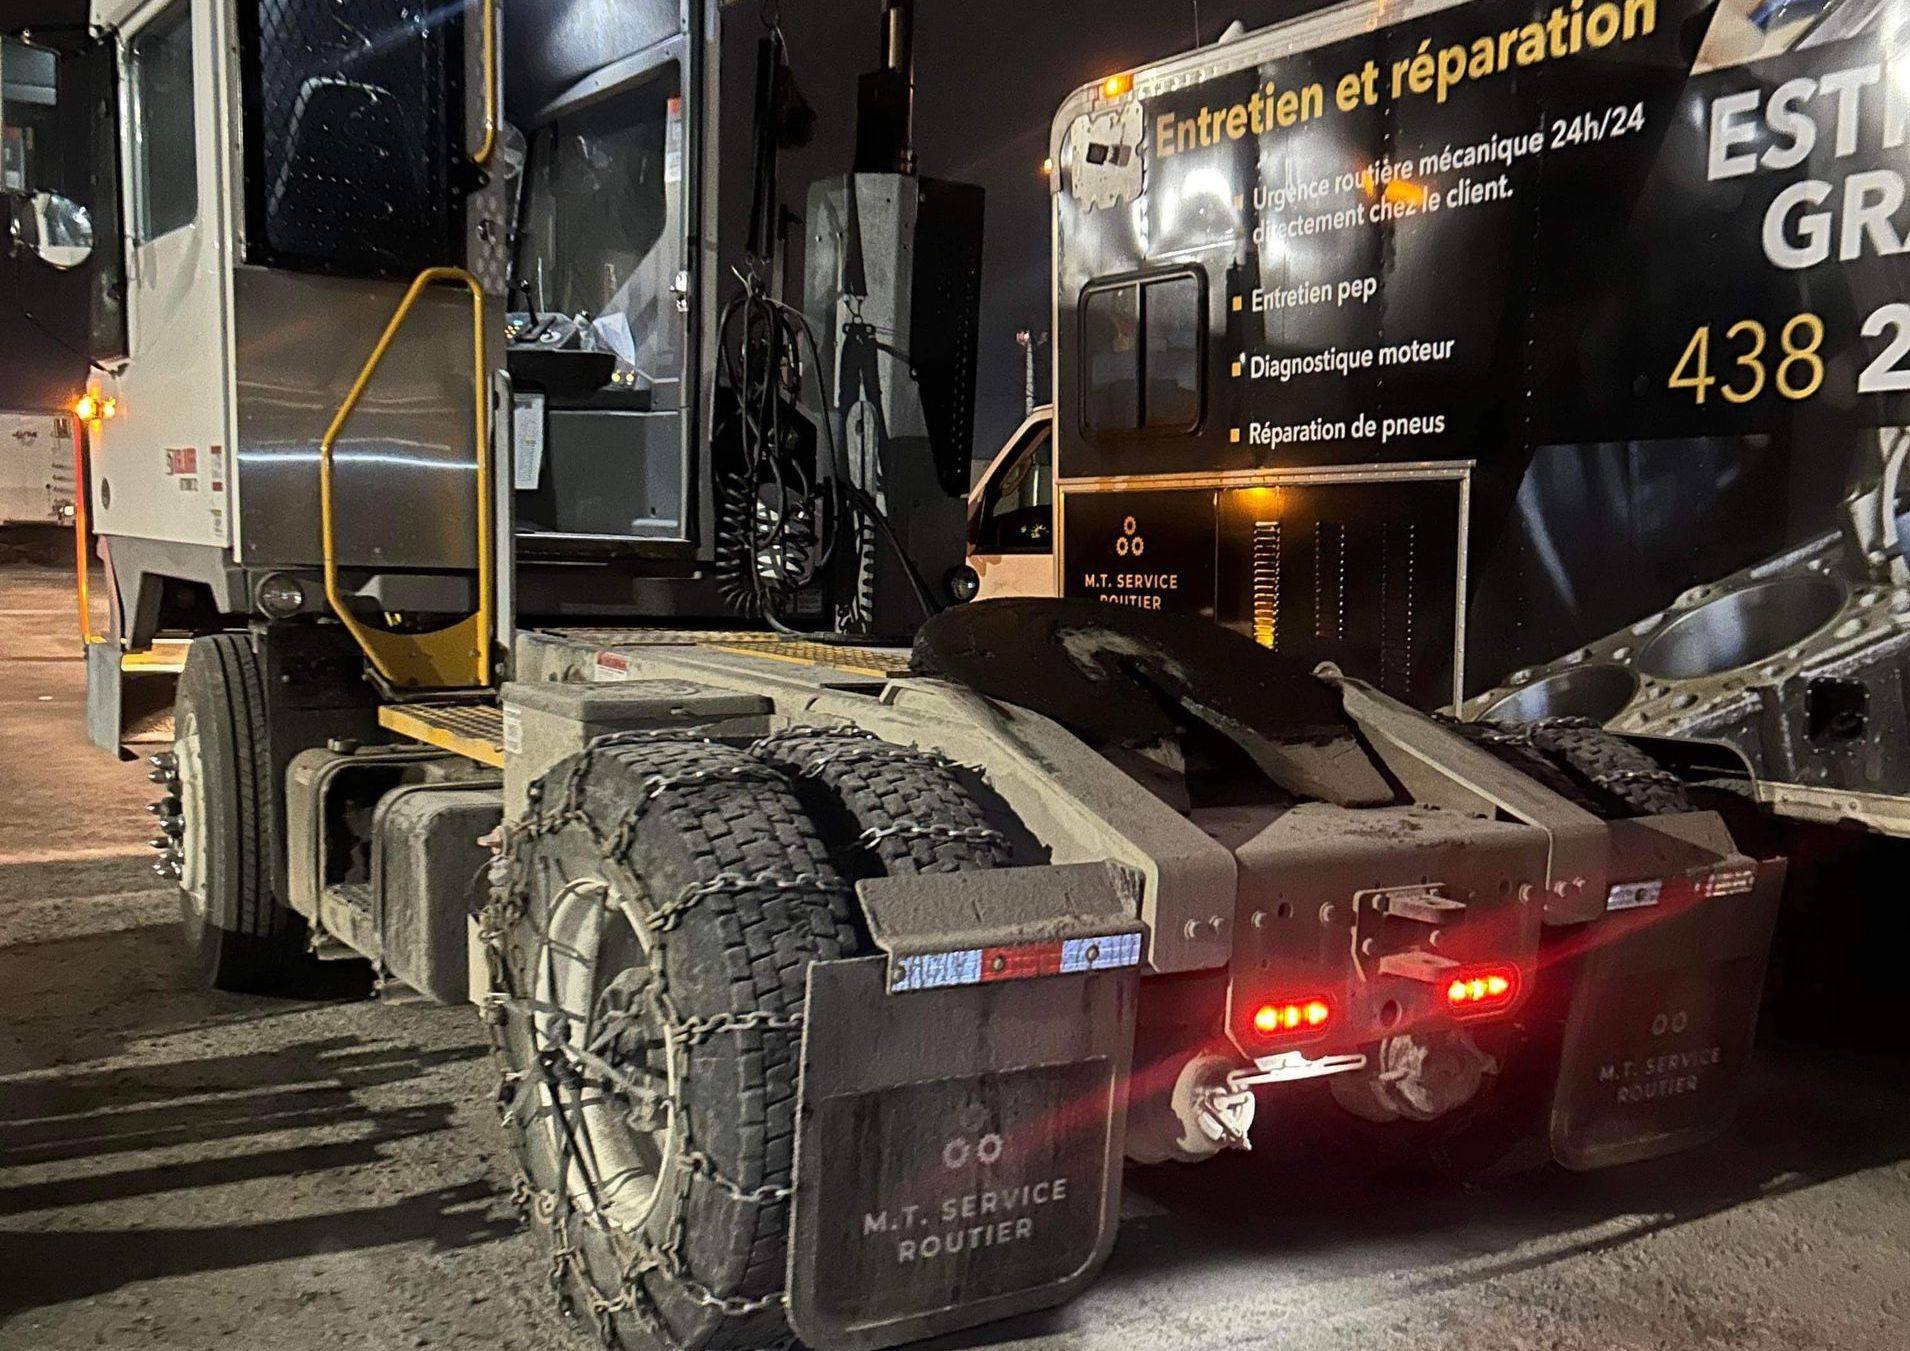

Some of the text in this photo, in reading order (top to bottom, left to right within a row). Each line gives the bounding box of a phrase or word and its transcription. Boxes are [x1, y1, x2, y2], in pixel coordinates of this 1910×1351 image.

[1155, 0, 1657, 159] Entretien et réparation
[1253, 101, 1646, 212] Urgence routière mécanique 24h/24
[1422, 185, 1440, 214] le
[1446, 173, 1513, 208] client.
[1762, 169, 1910, 270] GR
[1251, 277, 1378, 312] Entretien pep
[1250, 338, 1455, 381] Diagnostique moteur
[1668, 313, 1825, 404] 438
[1248, 412, 1446, 448] Réparation de pneus
[1085, 573, 1178, 589] M.T. SERVICE
[862, 1177, 1068, 1235] M.T. SERVICE
[898, 1218, 1034, 1262] ROUTIER
